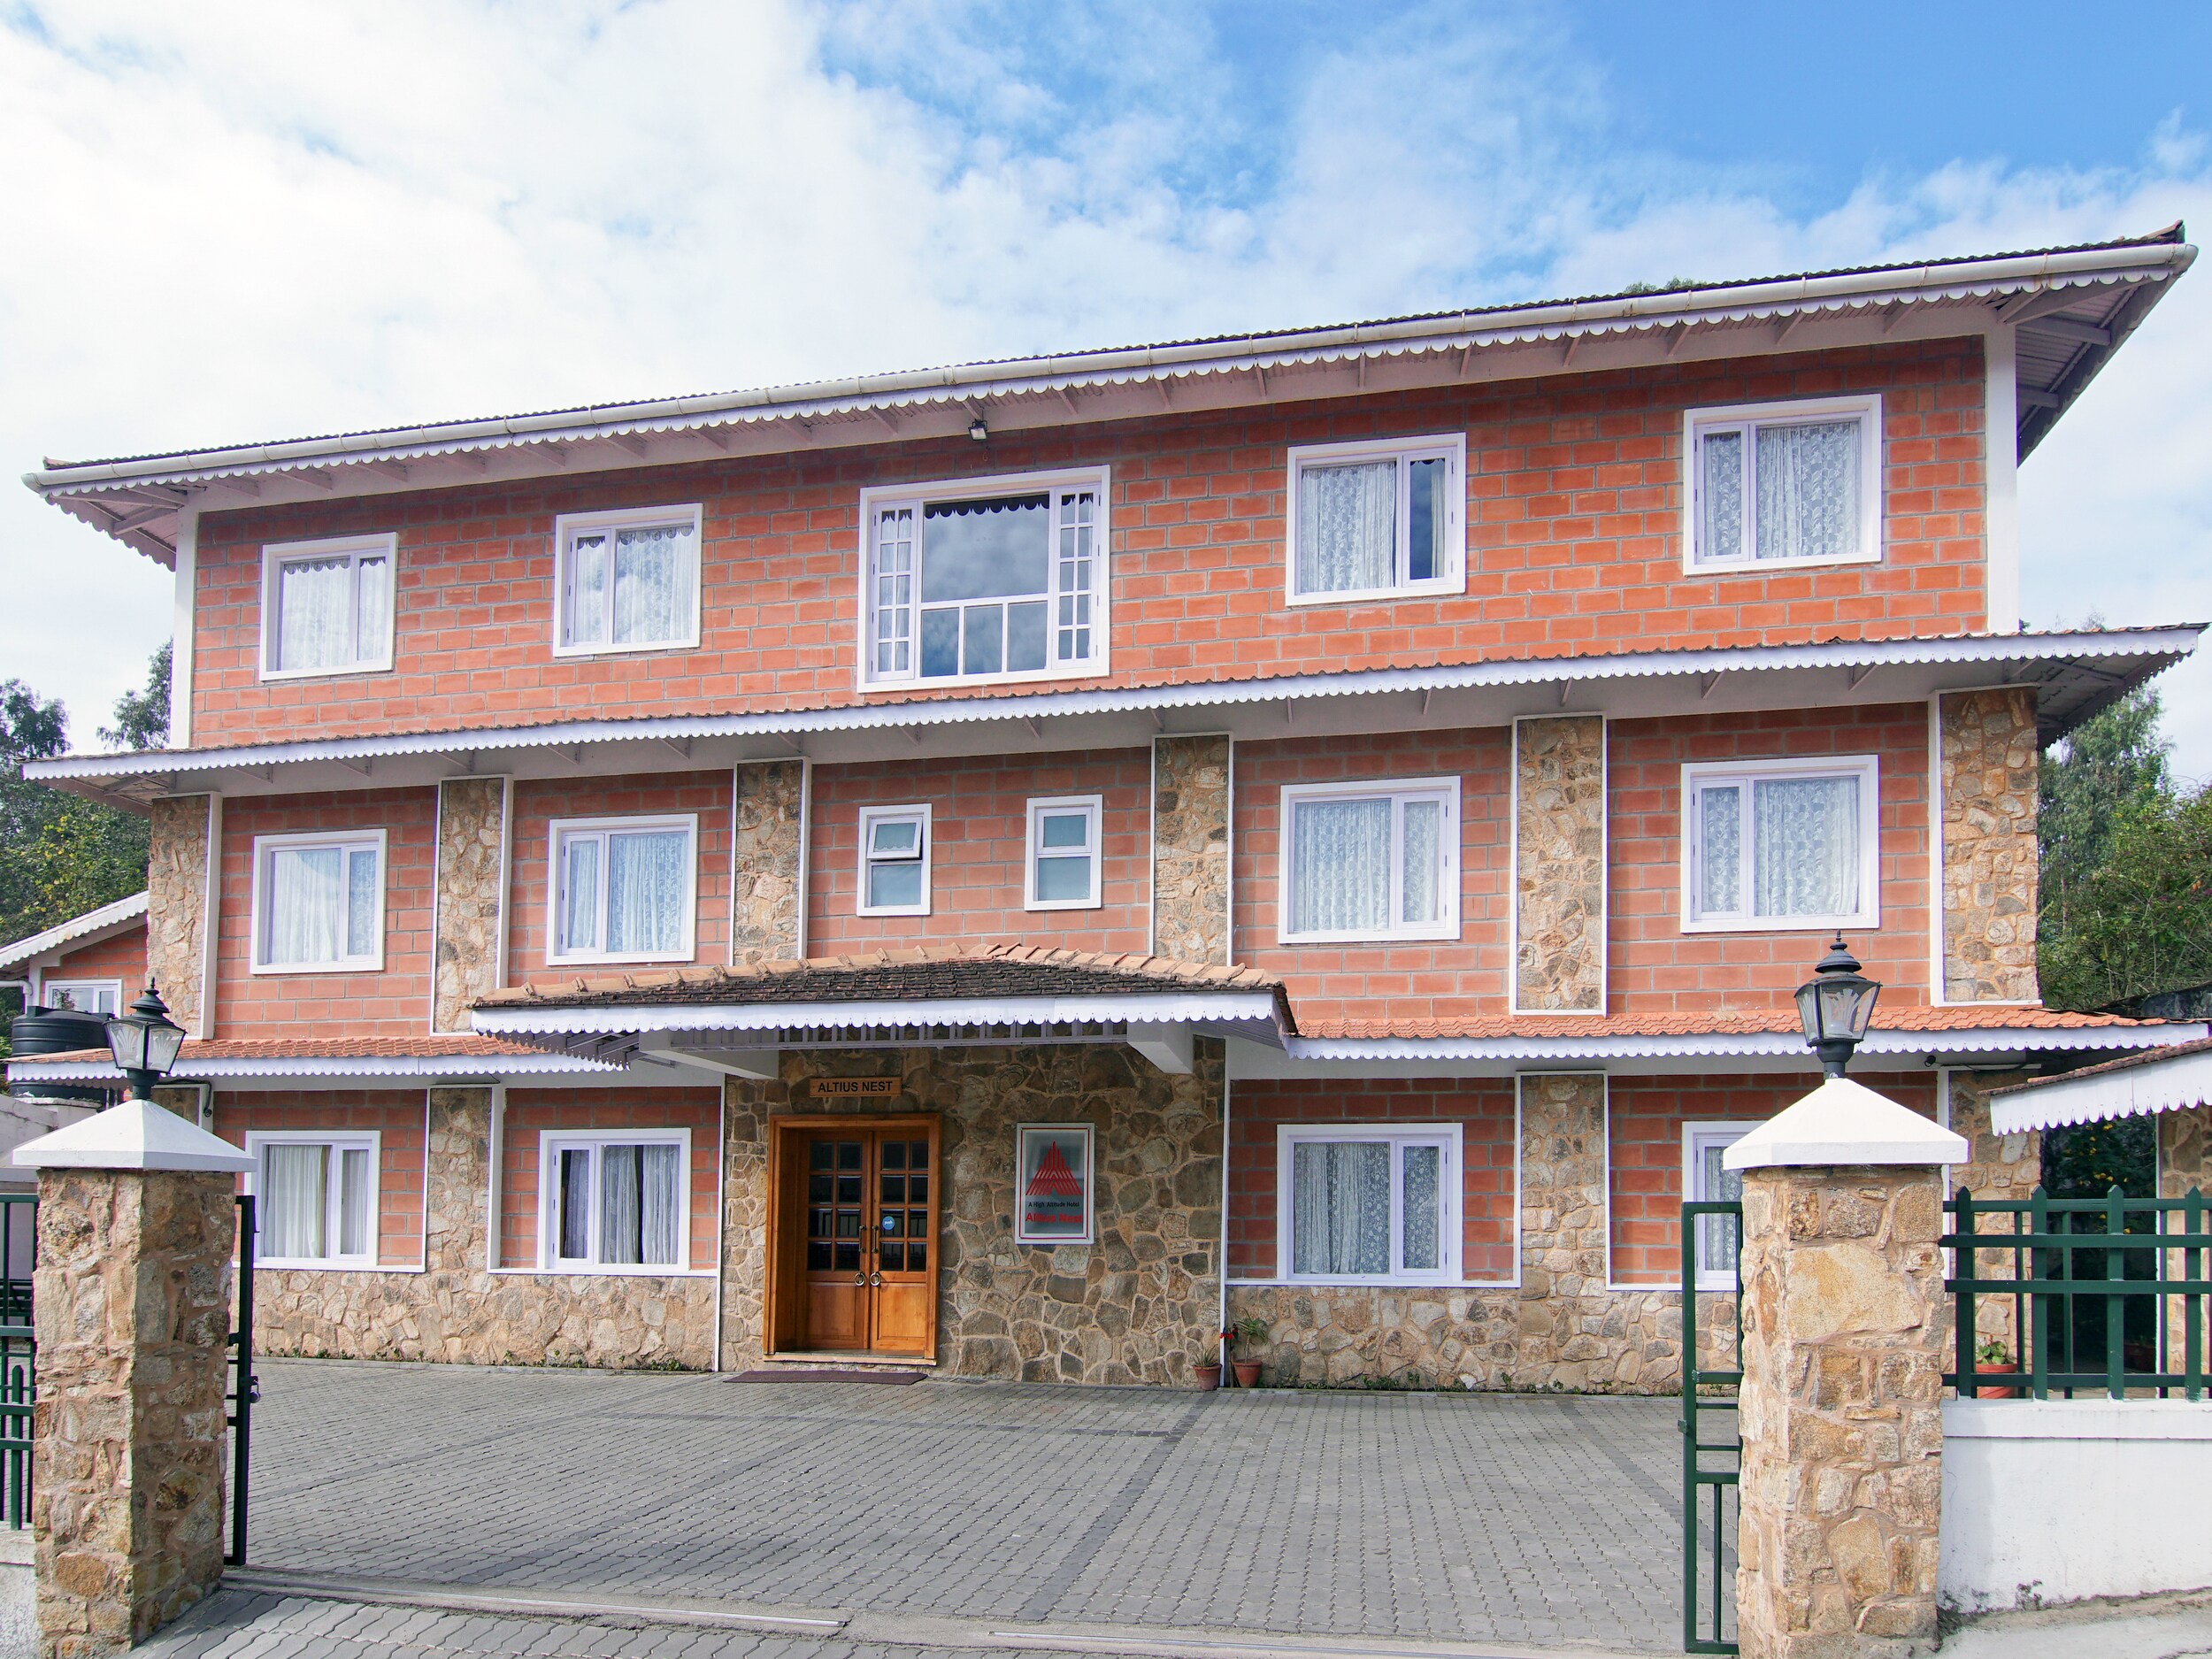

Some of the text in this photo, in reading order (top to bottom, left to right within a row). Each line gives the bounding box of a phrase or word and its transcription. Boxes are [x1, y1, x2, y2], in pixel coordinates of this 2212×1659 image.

[818, 1081, 893, 1093] ALTIUS NEST
[1025, 1212, 1083, 1224] Altius Nest
